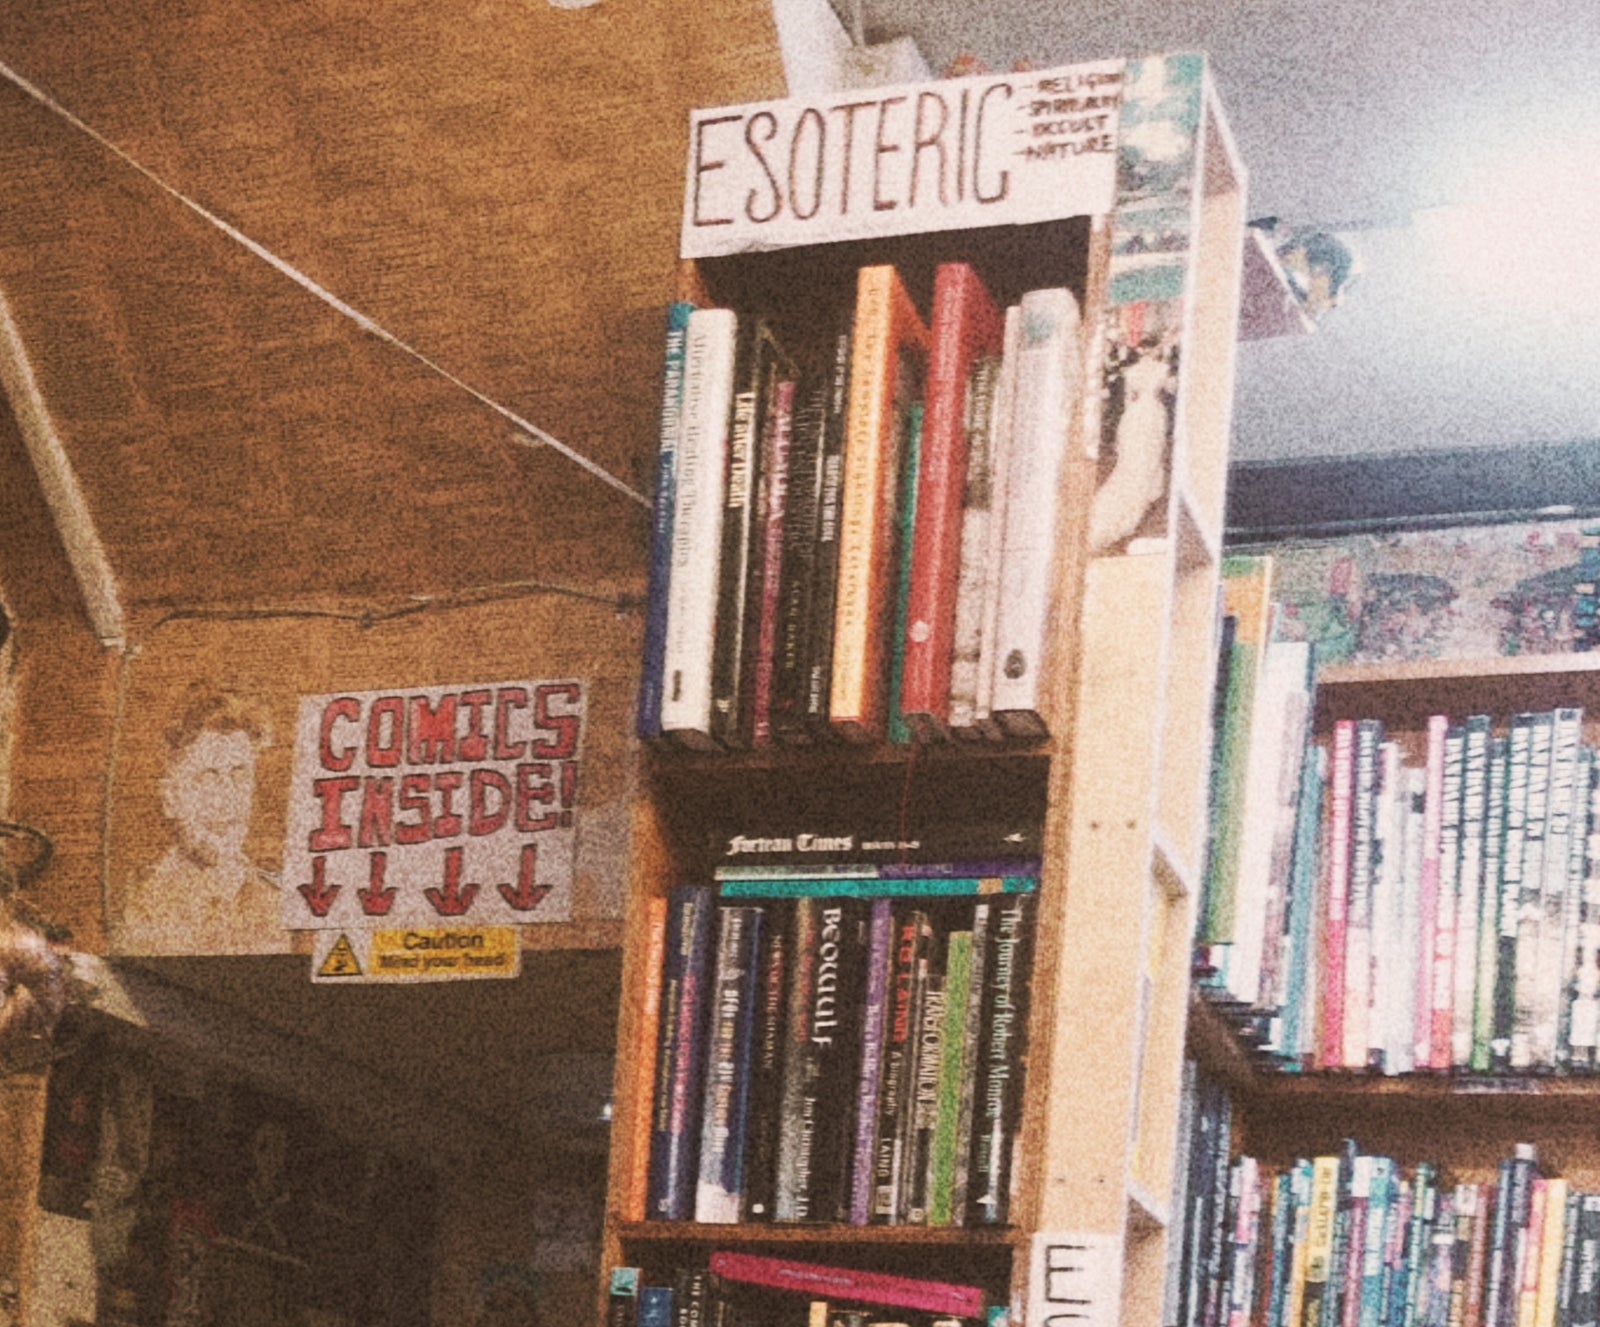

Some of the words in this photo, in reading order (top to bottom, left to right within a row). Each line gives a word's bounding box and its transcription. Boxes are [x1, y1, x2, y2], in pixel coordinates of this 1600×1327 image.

[692, 83, 1013, 228] ESOTERIC
[317, 683, 582, 772] COMICS
[309, 761, 578, 853] INSIDE!
[795, 832, 854, 852] Times
[402, 931, 485, 951] Caution
[990, 937, 1018, 992] Journey
[995, 994, 1015, 1011] of
[989, 1012, 1013, 1060] Robert
